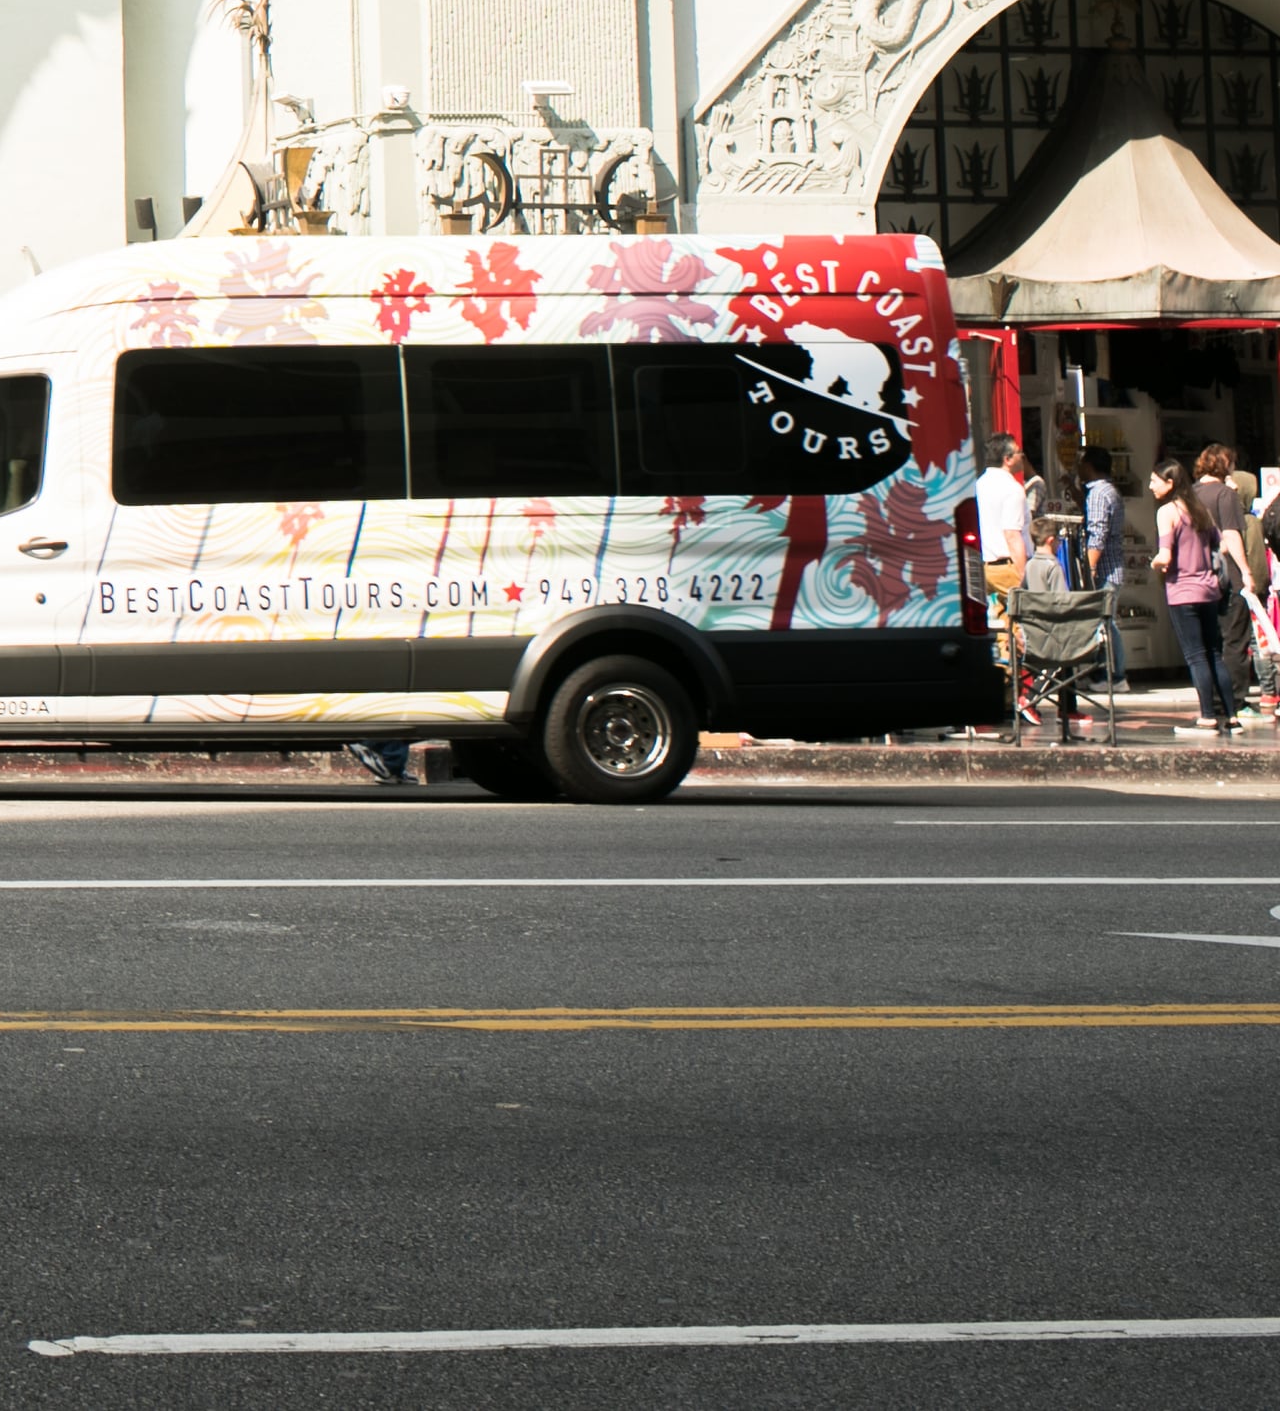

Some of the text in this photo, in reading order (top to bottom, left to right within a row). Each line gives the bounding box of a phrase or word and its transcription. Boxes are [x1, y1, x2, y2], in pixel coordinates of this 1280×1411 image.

[749, 260, 937, 378] BEST COAST
[747, 380, 891, 460] TOURS
[539, 573, 764, 605] 949.328.4222
